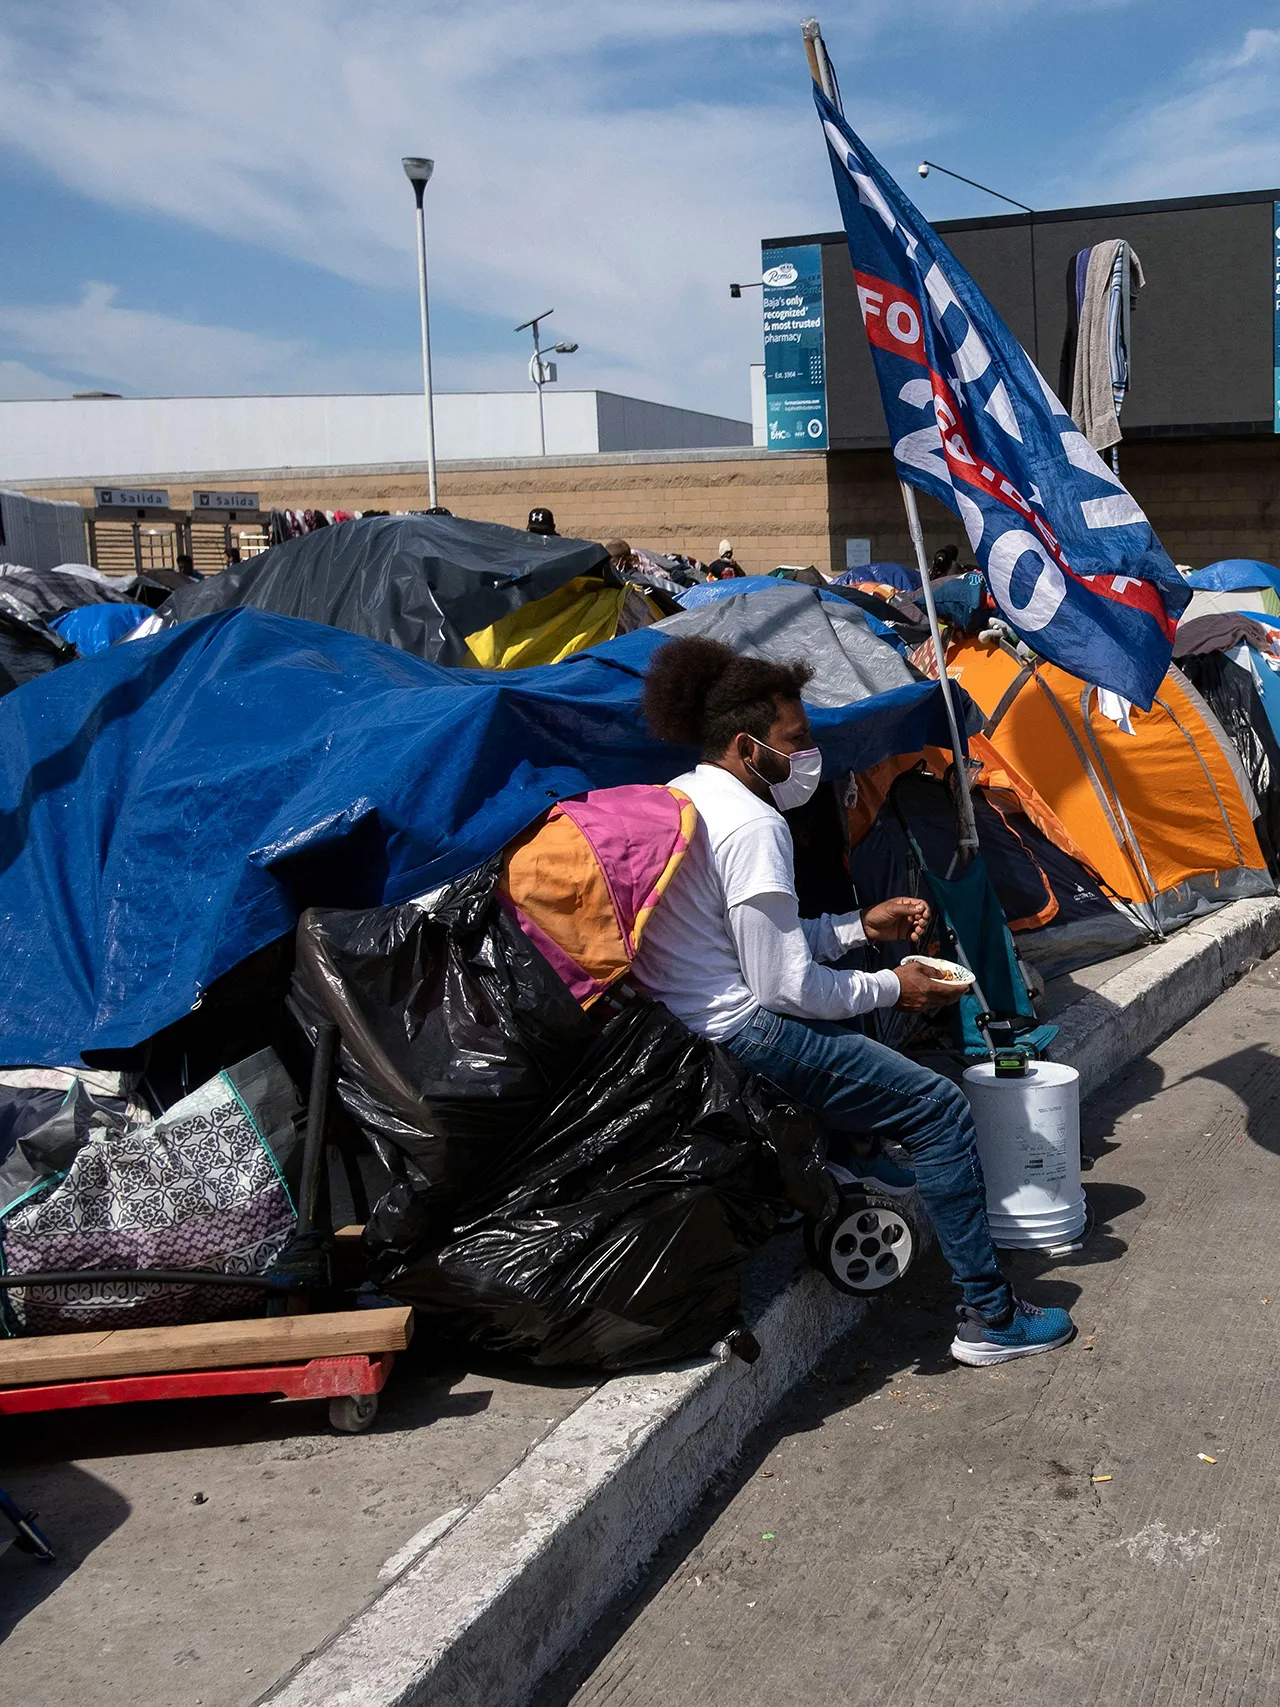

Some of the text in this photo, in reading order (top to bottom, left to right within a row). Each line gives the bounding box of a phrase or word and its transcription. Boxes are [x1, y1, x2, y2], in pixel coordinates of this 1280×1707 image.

[768, 271, 792, 283] Roma
[764, 295, 803, 309] Baja's only
[764, 317, 820, 331] & most trusted
[764, 333, 802, 345] pharmacy
[120, 493, 163, 504] Salida
[217, 496, 254, 506] Salida
